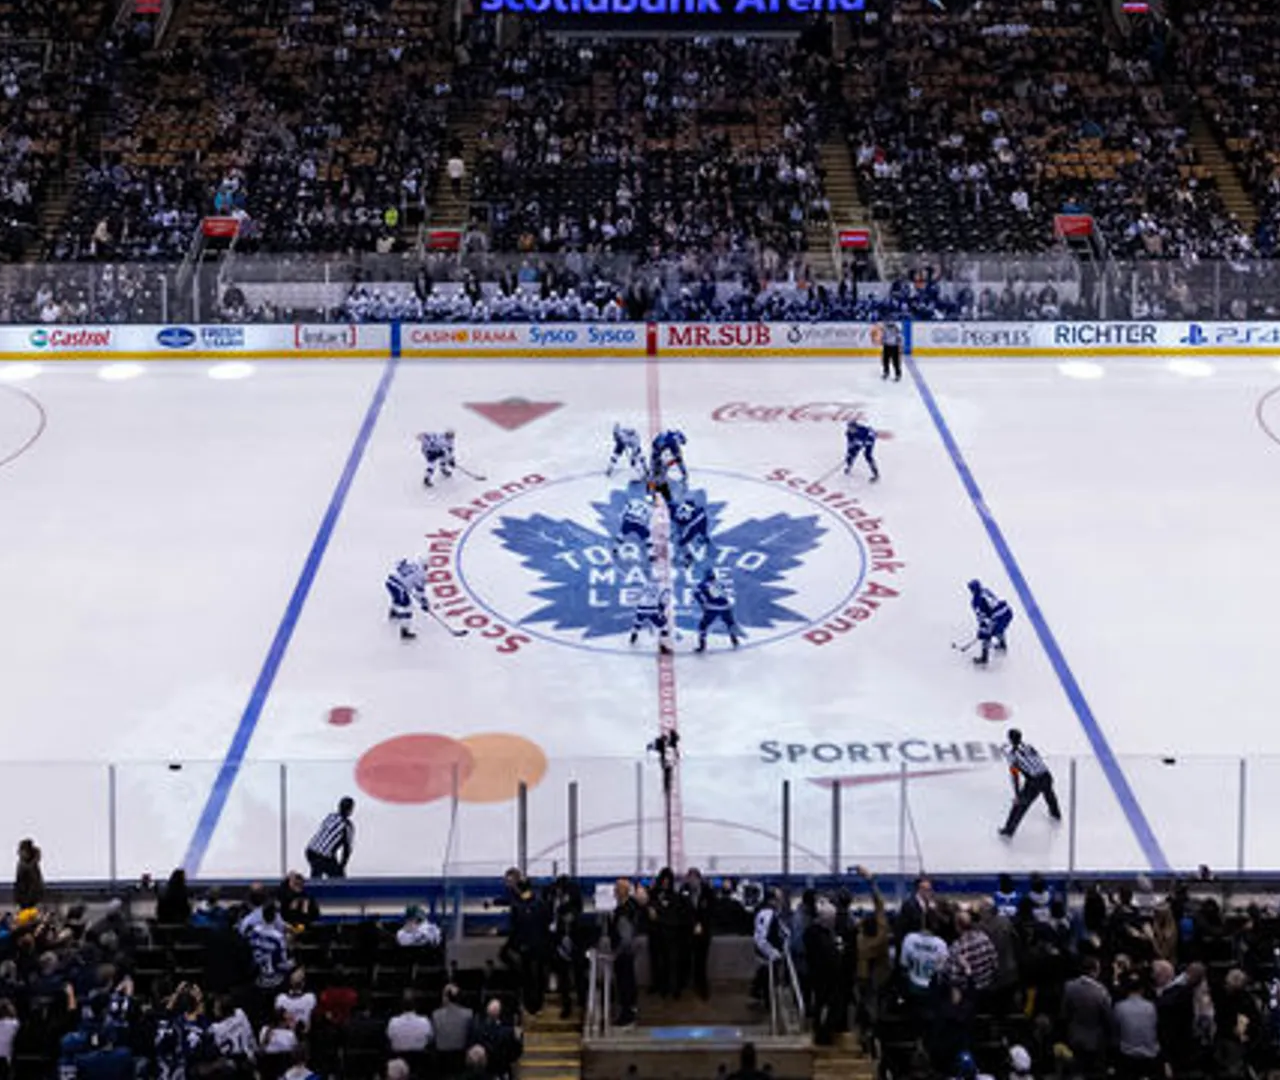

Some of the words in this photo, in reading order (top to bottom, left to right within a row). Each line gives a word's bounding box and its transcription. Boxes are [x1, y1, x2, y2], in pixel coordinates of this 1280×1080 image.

[50, 329, 111, 347] Castrol
[412, 328, 470, 343] CASINO
[472, 328, 518, 343] RAMA
[529, 326, 578, 345] Sysco
[588, 326, 636, 345] Sysco
[667, 325, 771, 347] MR.SUB
[1054, 325, 1157, 344] RICHTER
[1216, 326, 1280, 343] PS4
[447, 473, 546, 521] Arena
[765, 468, 905, 573] Scotiabank
[424, 527, 533, 654] Scotiabank
[801, 581, 900, 646] Arena
